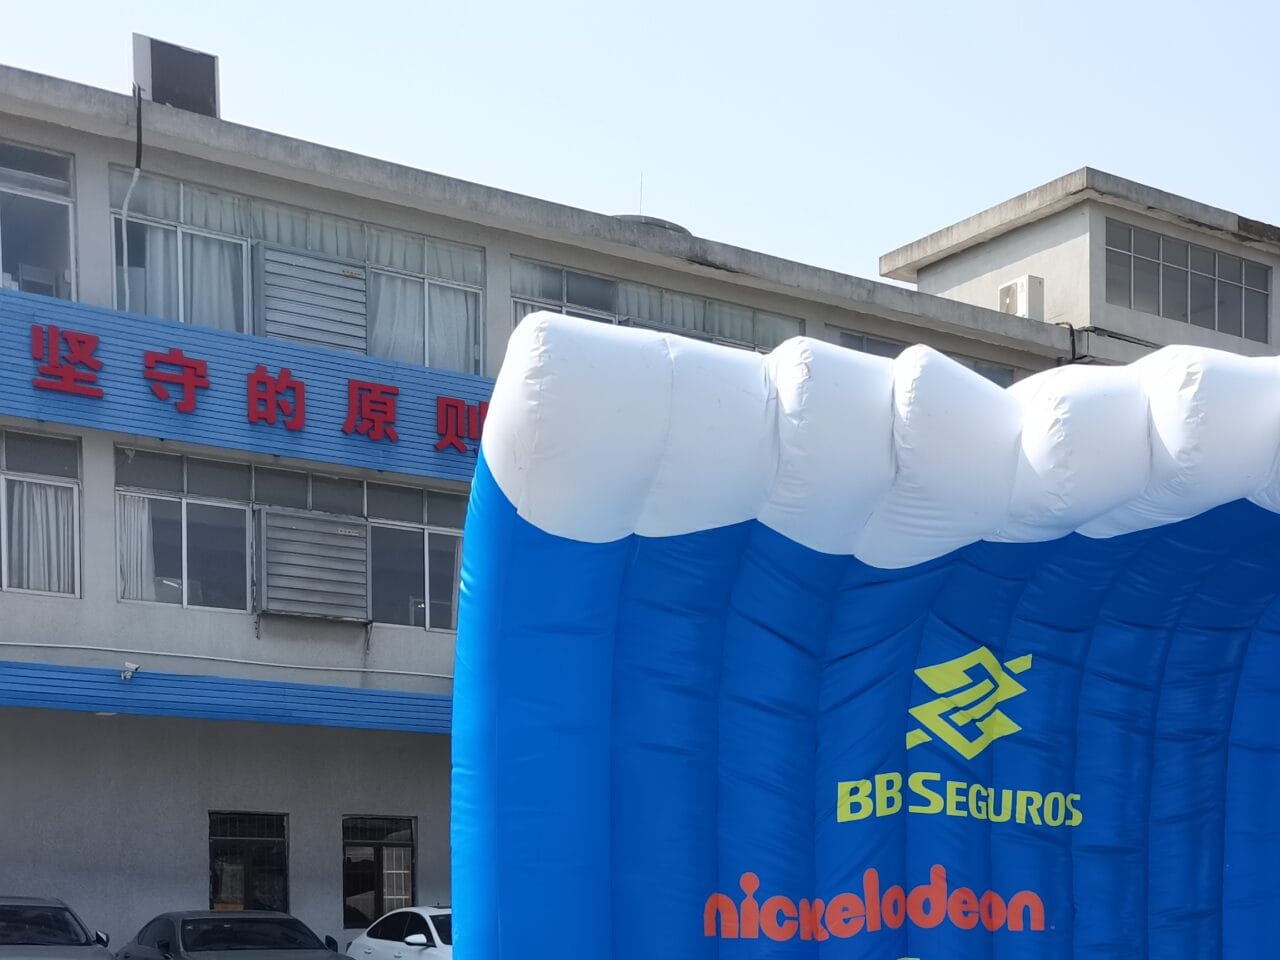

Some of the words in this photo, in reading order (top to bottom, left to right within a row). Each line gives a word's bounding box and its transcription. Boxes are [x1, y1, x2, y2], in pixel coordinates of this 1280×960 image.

[32, 324, 489, 453] 坚守的原则
[704, 864, 1045, 941] nickelodeon
